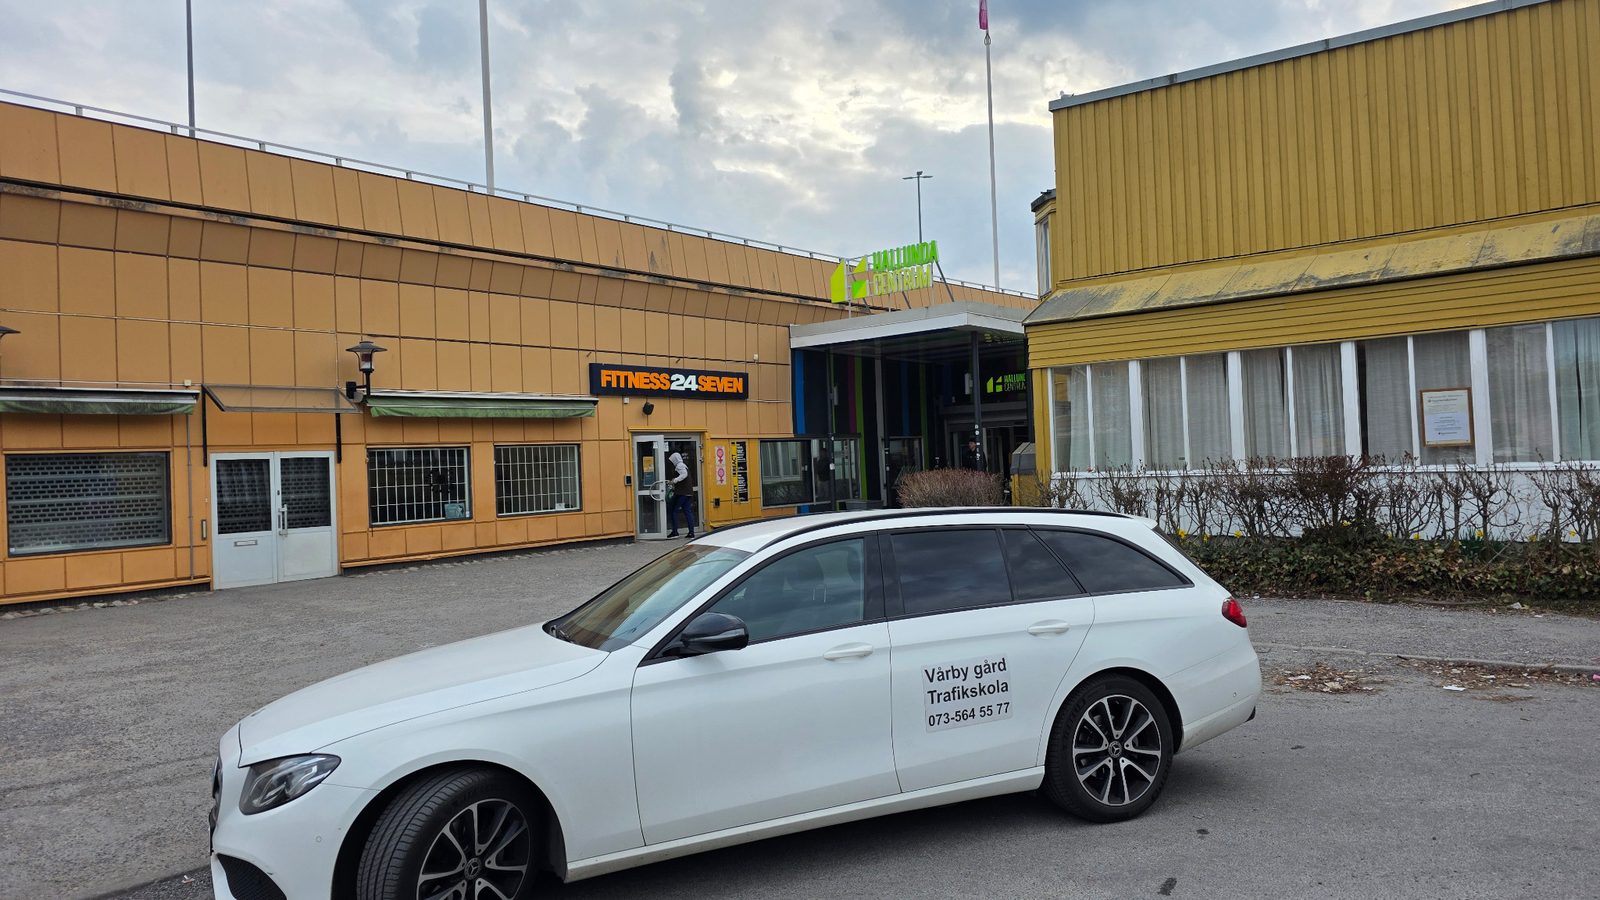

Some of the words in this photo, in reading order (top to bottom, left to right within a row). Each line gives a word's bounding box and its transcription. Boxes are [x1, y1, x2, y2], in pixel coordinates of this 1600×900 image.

[872, 239, 939, 272] HALLUNDA
[873, 262, 933, 296] CENTRUM
[924, 666, 969, 683] Vårby
[973, 657, 1007, 679] gård
[927, 679, 1009, 705] Trafikskola
[928, 707, 976, 727] 073-564
[979, 705, 993, 718] 55
[996, 702, 1010, 715] 77
